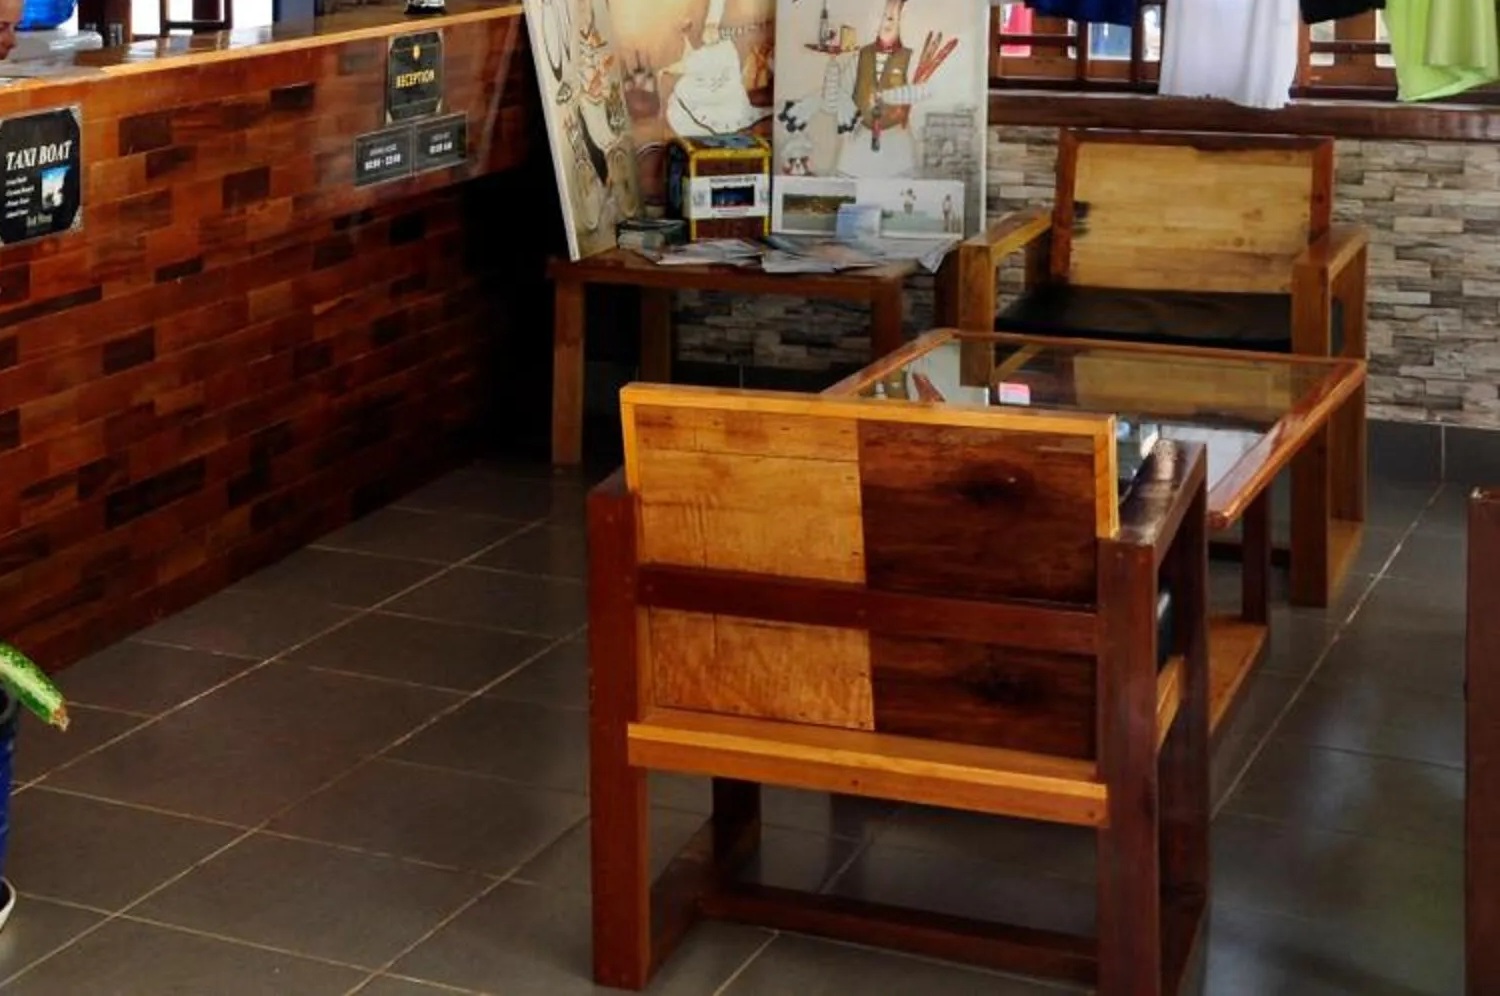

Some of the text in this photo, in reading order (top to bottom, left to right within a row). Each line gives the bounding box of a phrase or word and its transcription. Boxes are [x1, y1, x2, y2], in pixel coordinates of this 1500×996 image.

[395, 68, 436, 90] RECEPTION
[5, 139, 73, 172] TAXI BOAT
